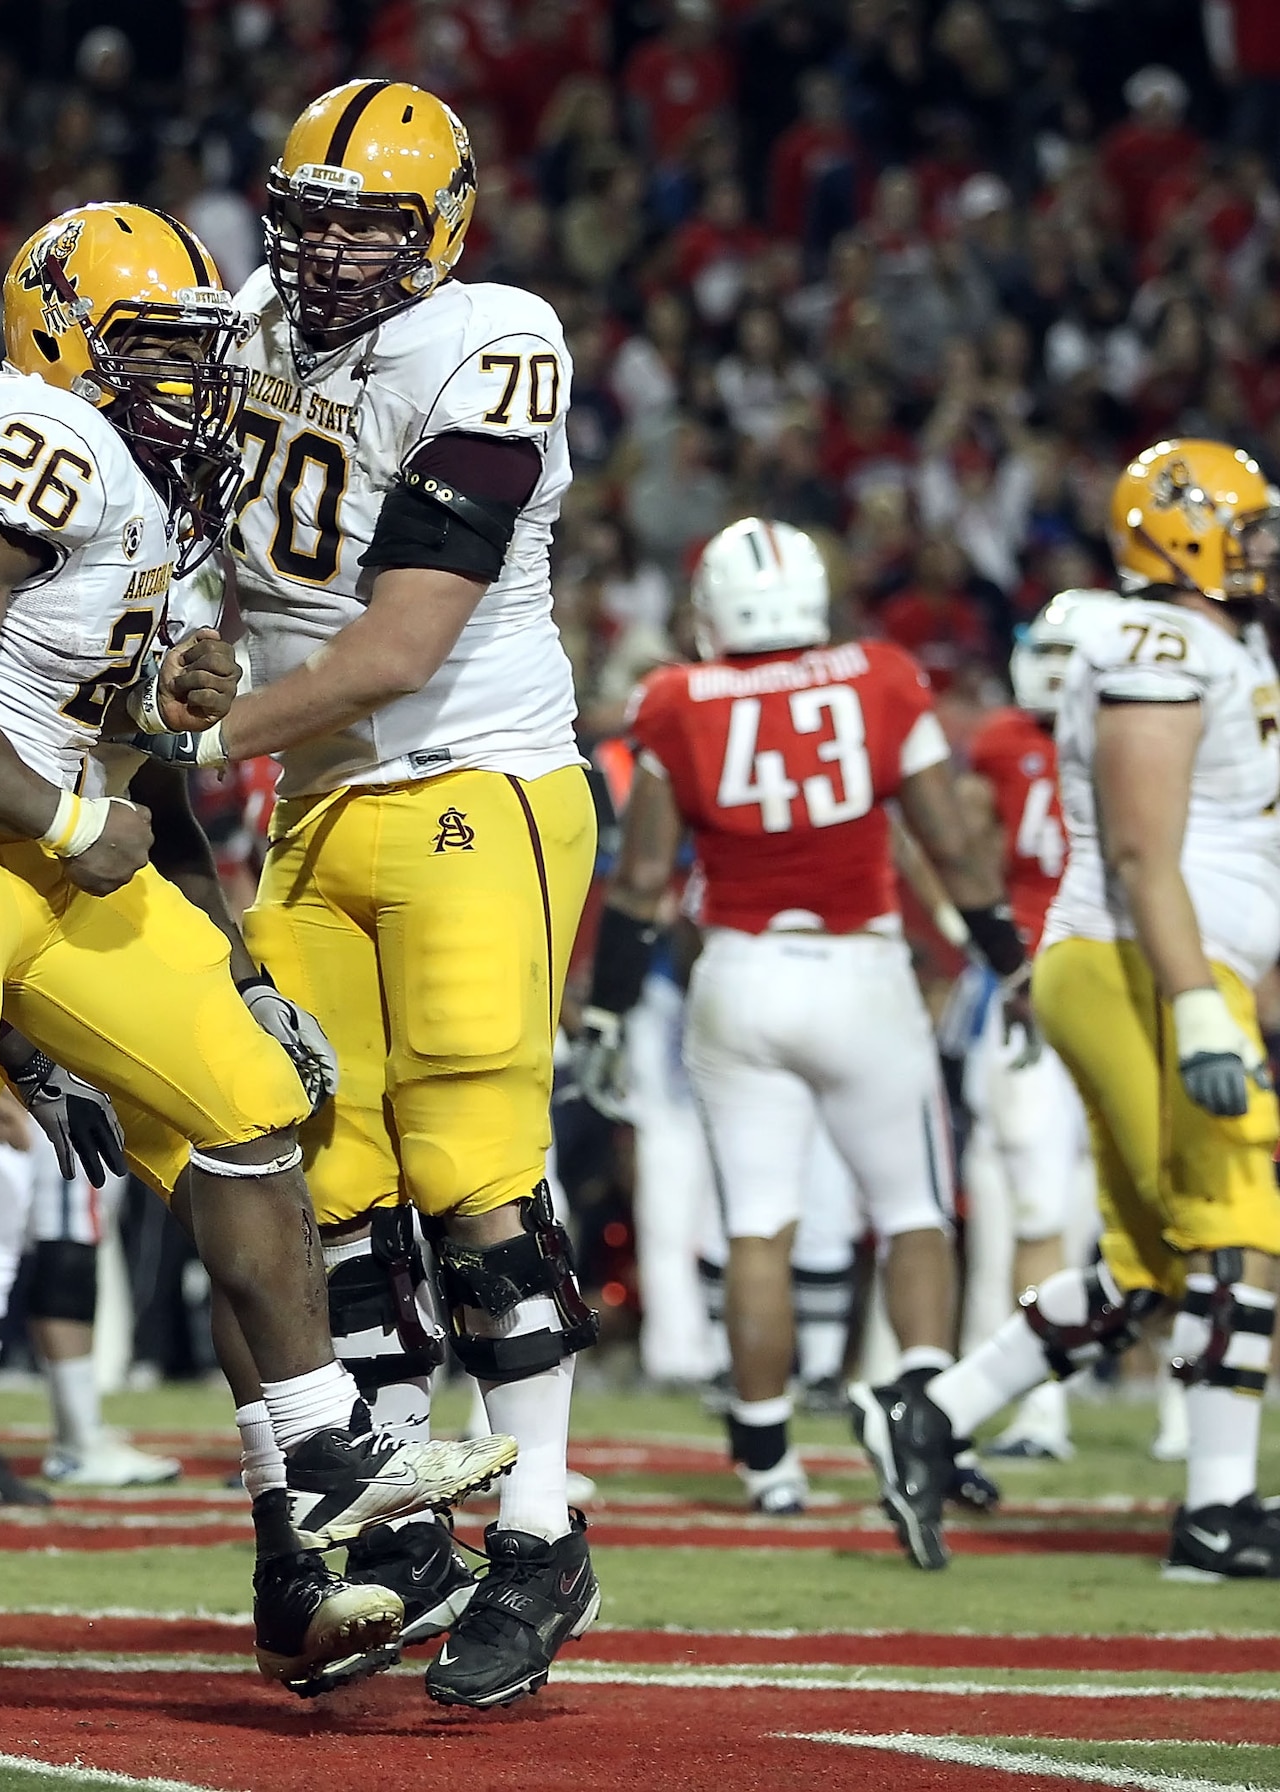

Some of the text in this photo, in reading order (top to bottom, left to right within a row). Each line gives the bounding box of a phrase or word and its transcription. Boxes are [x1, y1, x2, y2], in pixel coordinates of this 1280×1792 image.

[248, 368, 302, 416] RIZONA
[479, 352, 560, 426] 70
[228, 405, 350, 586] 70
[1120, 623, 1188, 663] 72
[717, 683, 874, 833] 43
